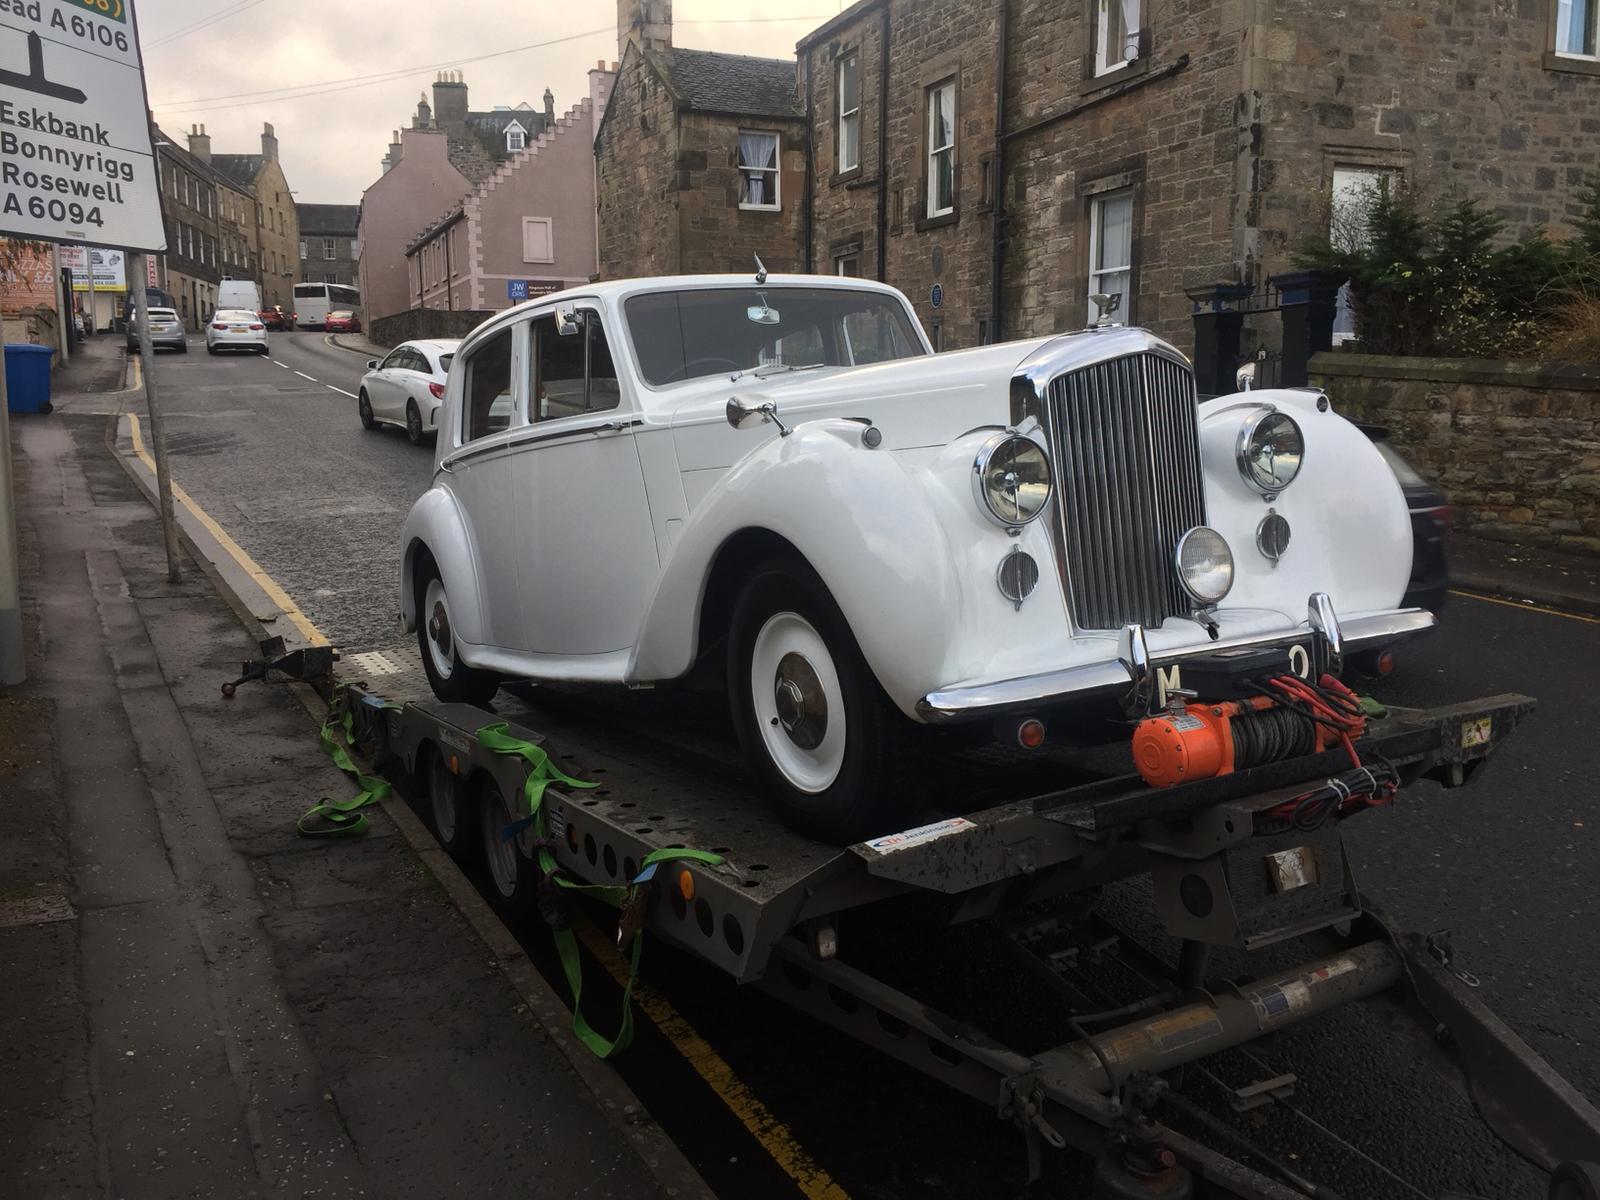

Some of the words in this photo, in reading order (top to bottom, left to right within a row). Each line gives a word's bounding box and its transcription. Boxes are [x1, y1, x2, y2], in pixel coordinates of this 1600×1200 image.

[0, 100, 110, 146] Eskbank
[1, 131, 134, 182] Bonnyrigg
[2, 161, 124, 204] Rosewell
[512, 283, 525, 291] JW
